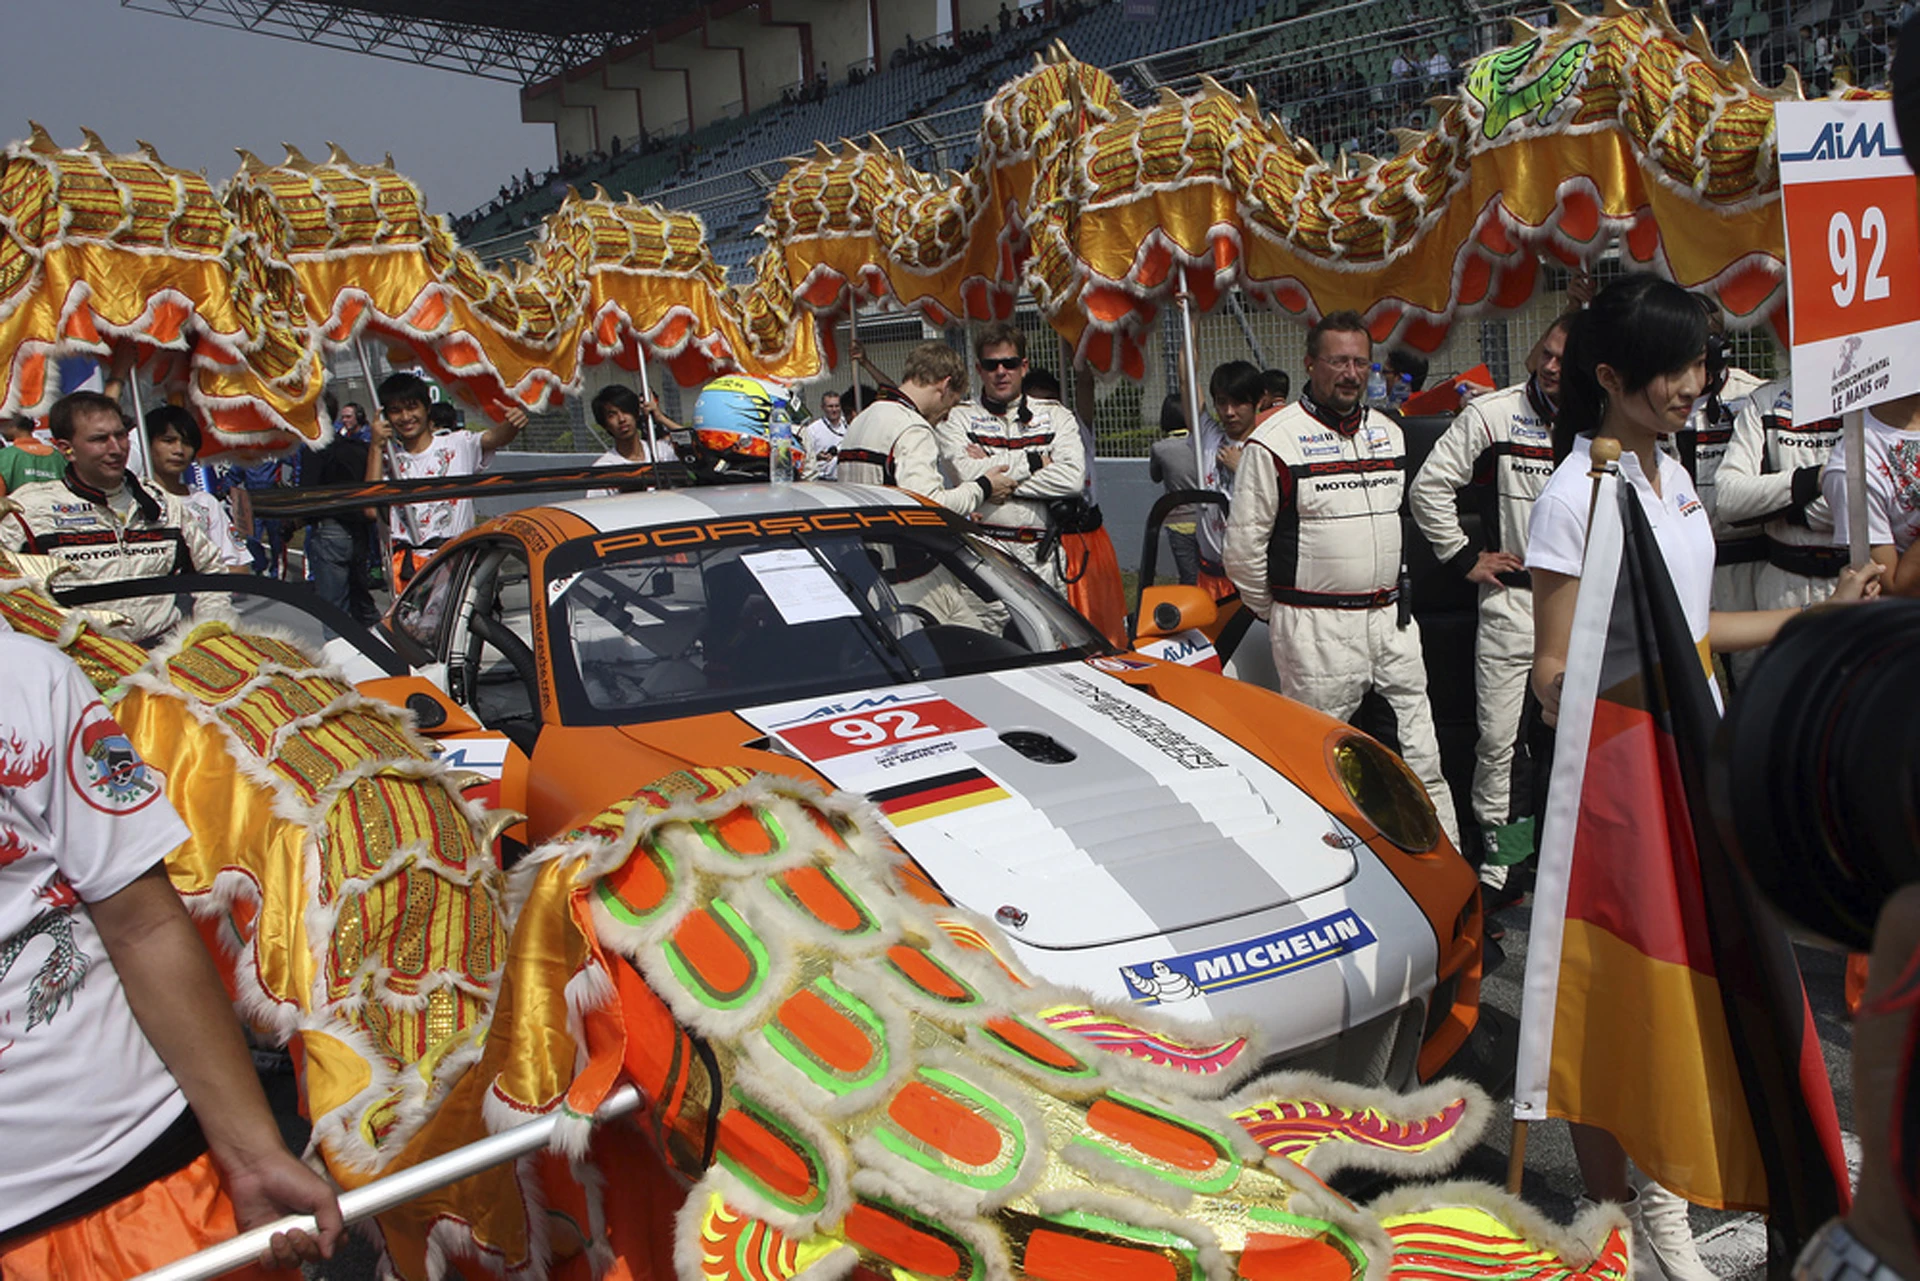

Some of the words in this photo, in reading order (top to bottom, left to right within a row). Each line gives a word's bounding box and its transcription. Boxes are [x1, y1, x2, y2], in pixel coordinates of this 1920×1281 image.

[1827, 206, 1890, 308] 92
[1831, 357, 1890, 396] INTERCONTINENTAL
[1832, 395, 1843, 414] LE
[1845, 379, 1872, 406] MANS
[1315, 476, 1399, 493] MOTORSPORT
[593, 508, 949, 558] PORSCHE
[64, 546, 169, 562] MOTORSPORT
[829, 709, 941, 746] 92
[1194, 916, 1361, 982] MICHELIN
